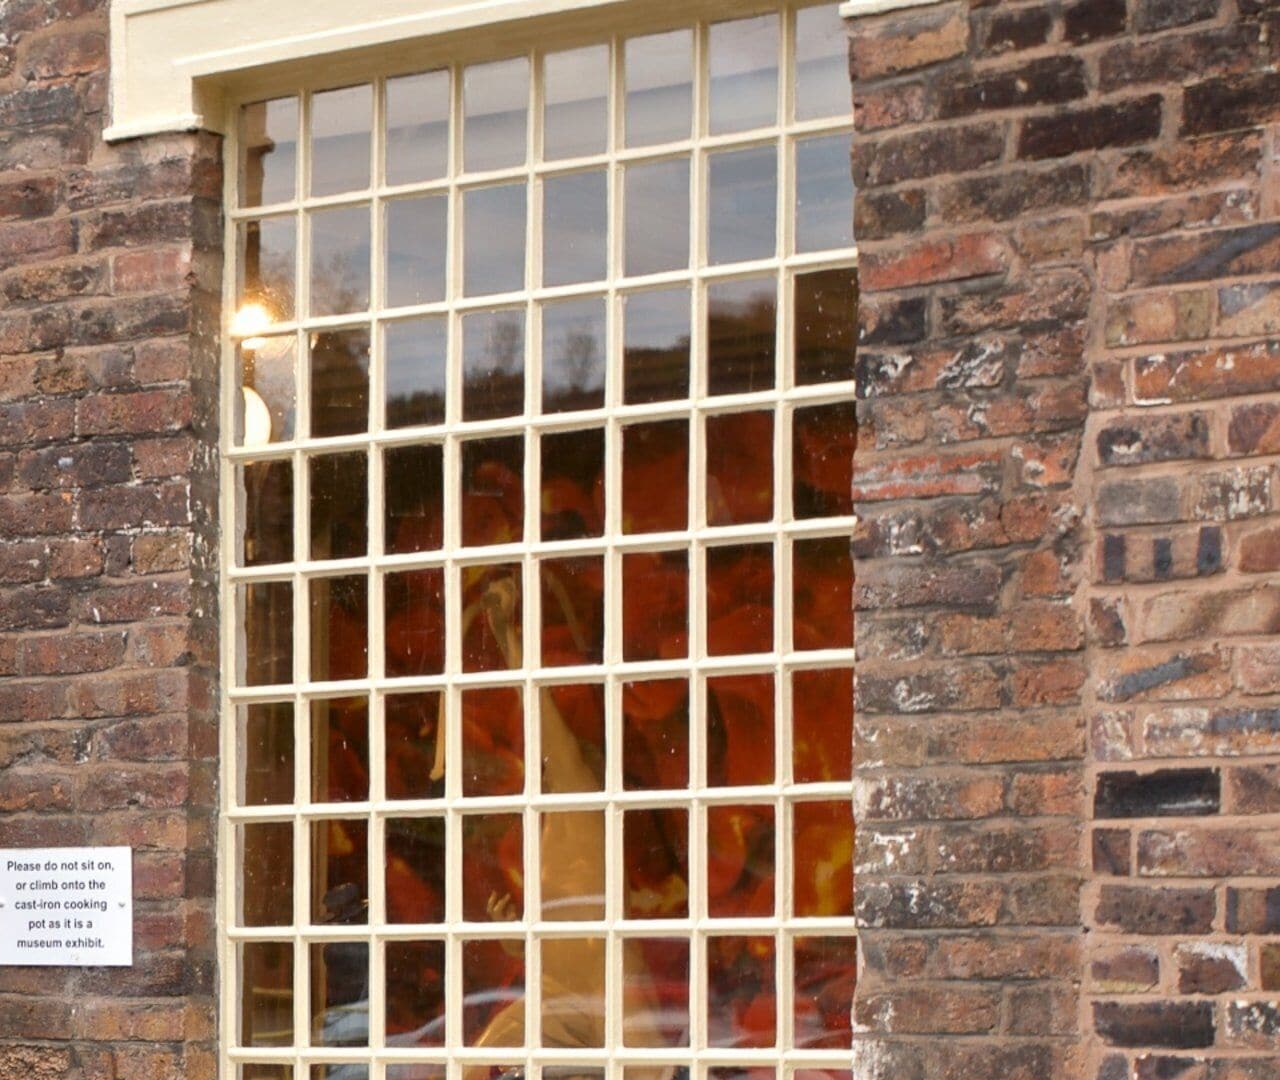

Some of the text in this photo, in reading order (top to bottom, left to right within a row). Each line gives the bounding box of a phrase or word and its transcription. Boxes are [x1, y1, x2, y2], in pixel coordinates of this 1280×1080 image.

[7, 860, 115, 872] Please do not sit on,
[15, 879, 106, 890] or climb onto the
[15, 899, 107, 912] cast-iron cooking
[28, 918, 93, 931] pot as it is a
[16, 937, 105, 948] museum exhibit.
